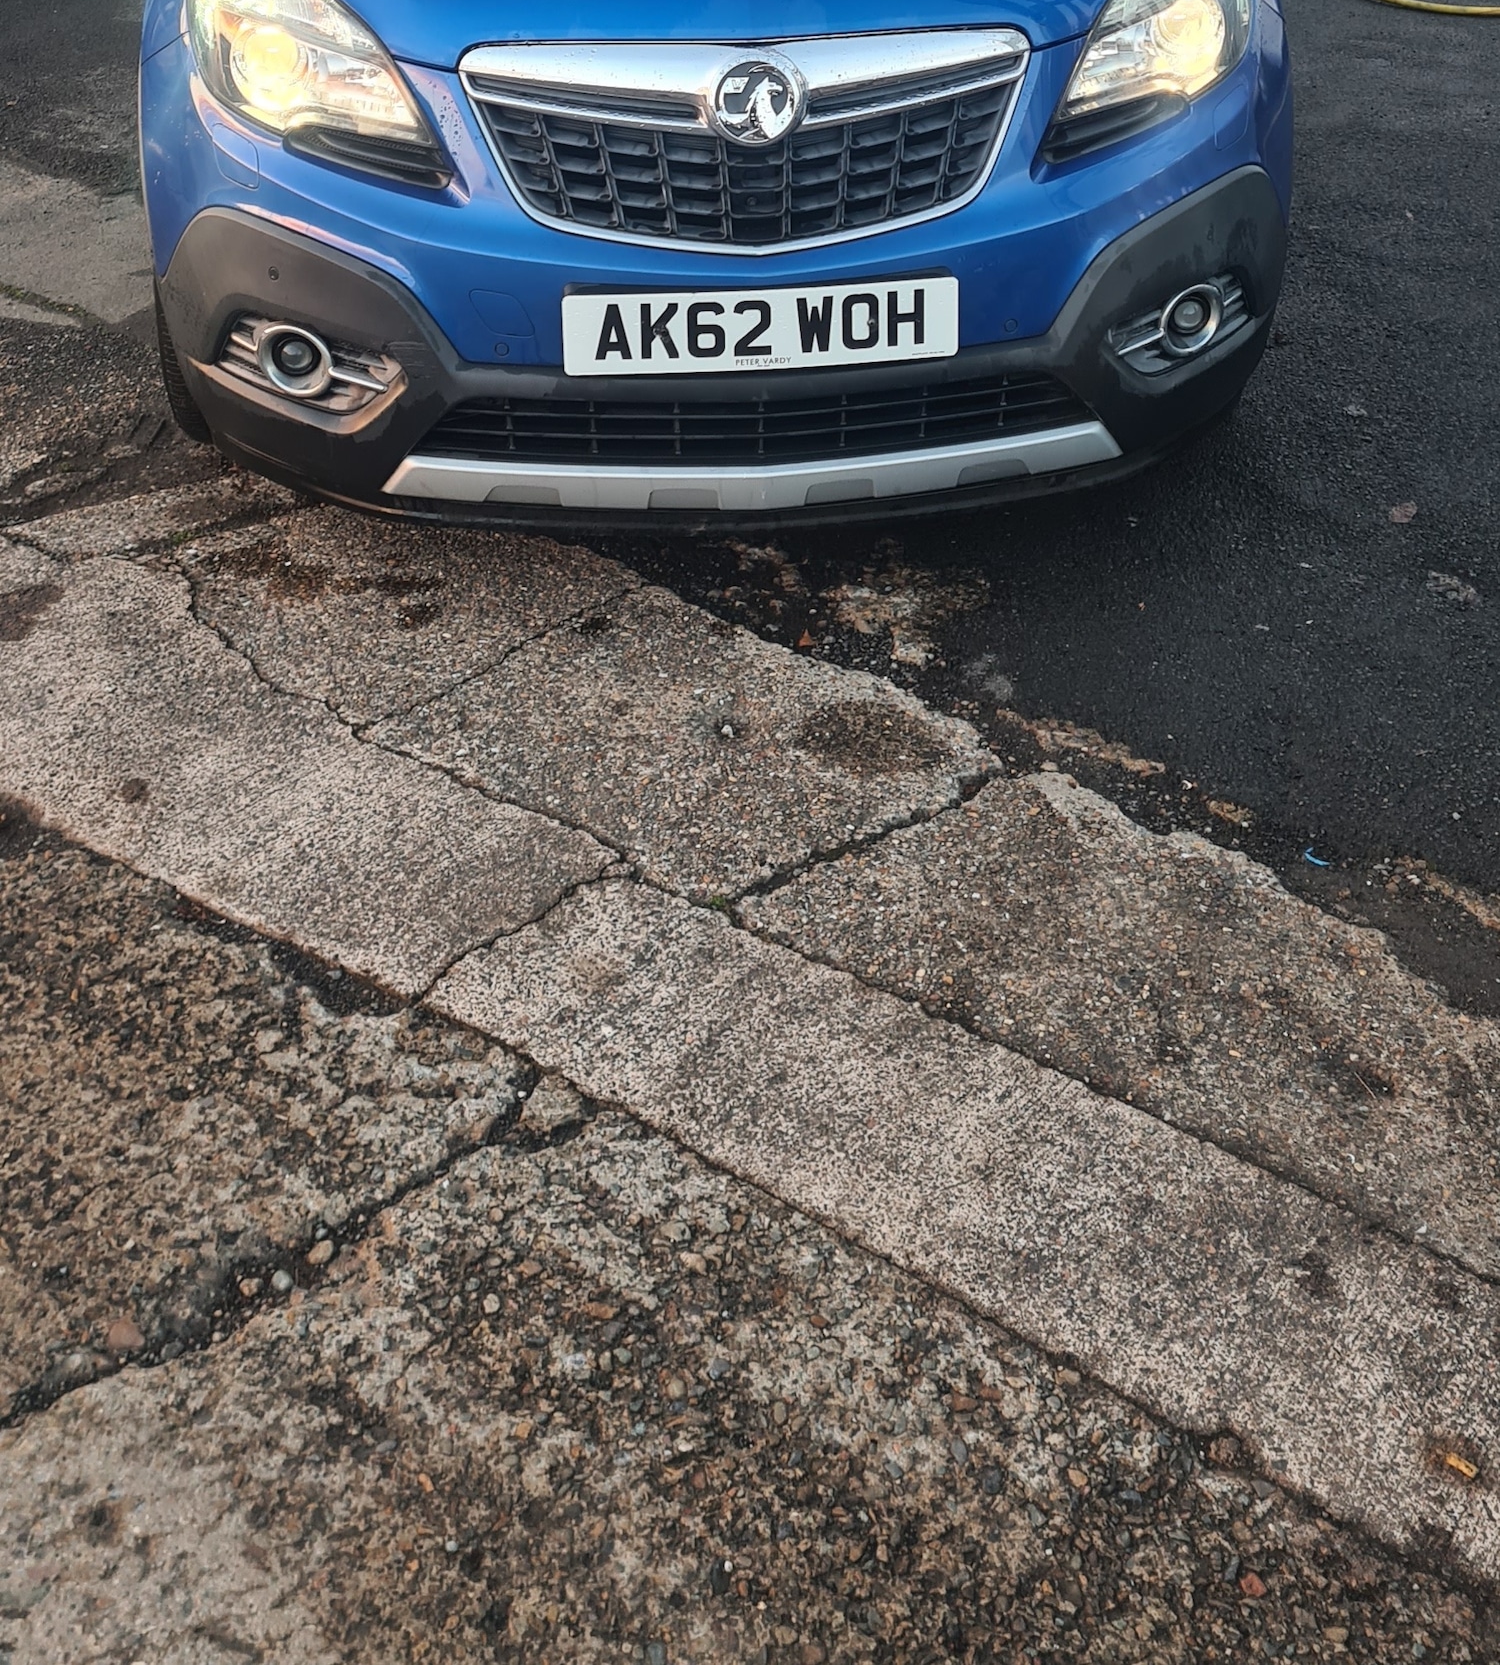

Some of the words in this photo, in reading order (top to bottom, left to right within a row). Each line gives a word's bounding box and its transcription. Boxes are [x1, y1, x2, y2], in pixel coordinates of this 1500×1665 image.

[594, 299, 773, 361] AK62
[796, 289, 925, 353] WOH
[735, 357, 760, 366] PETER
[761, 356, 792, 365] VARDY
